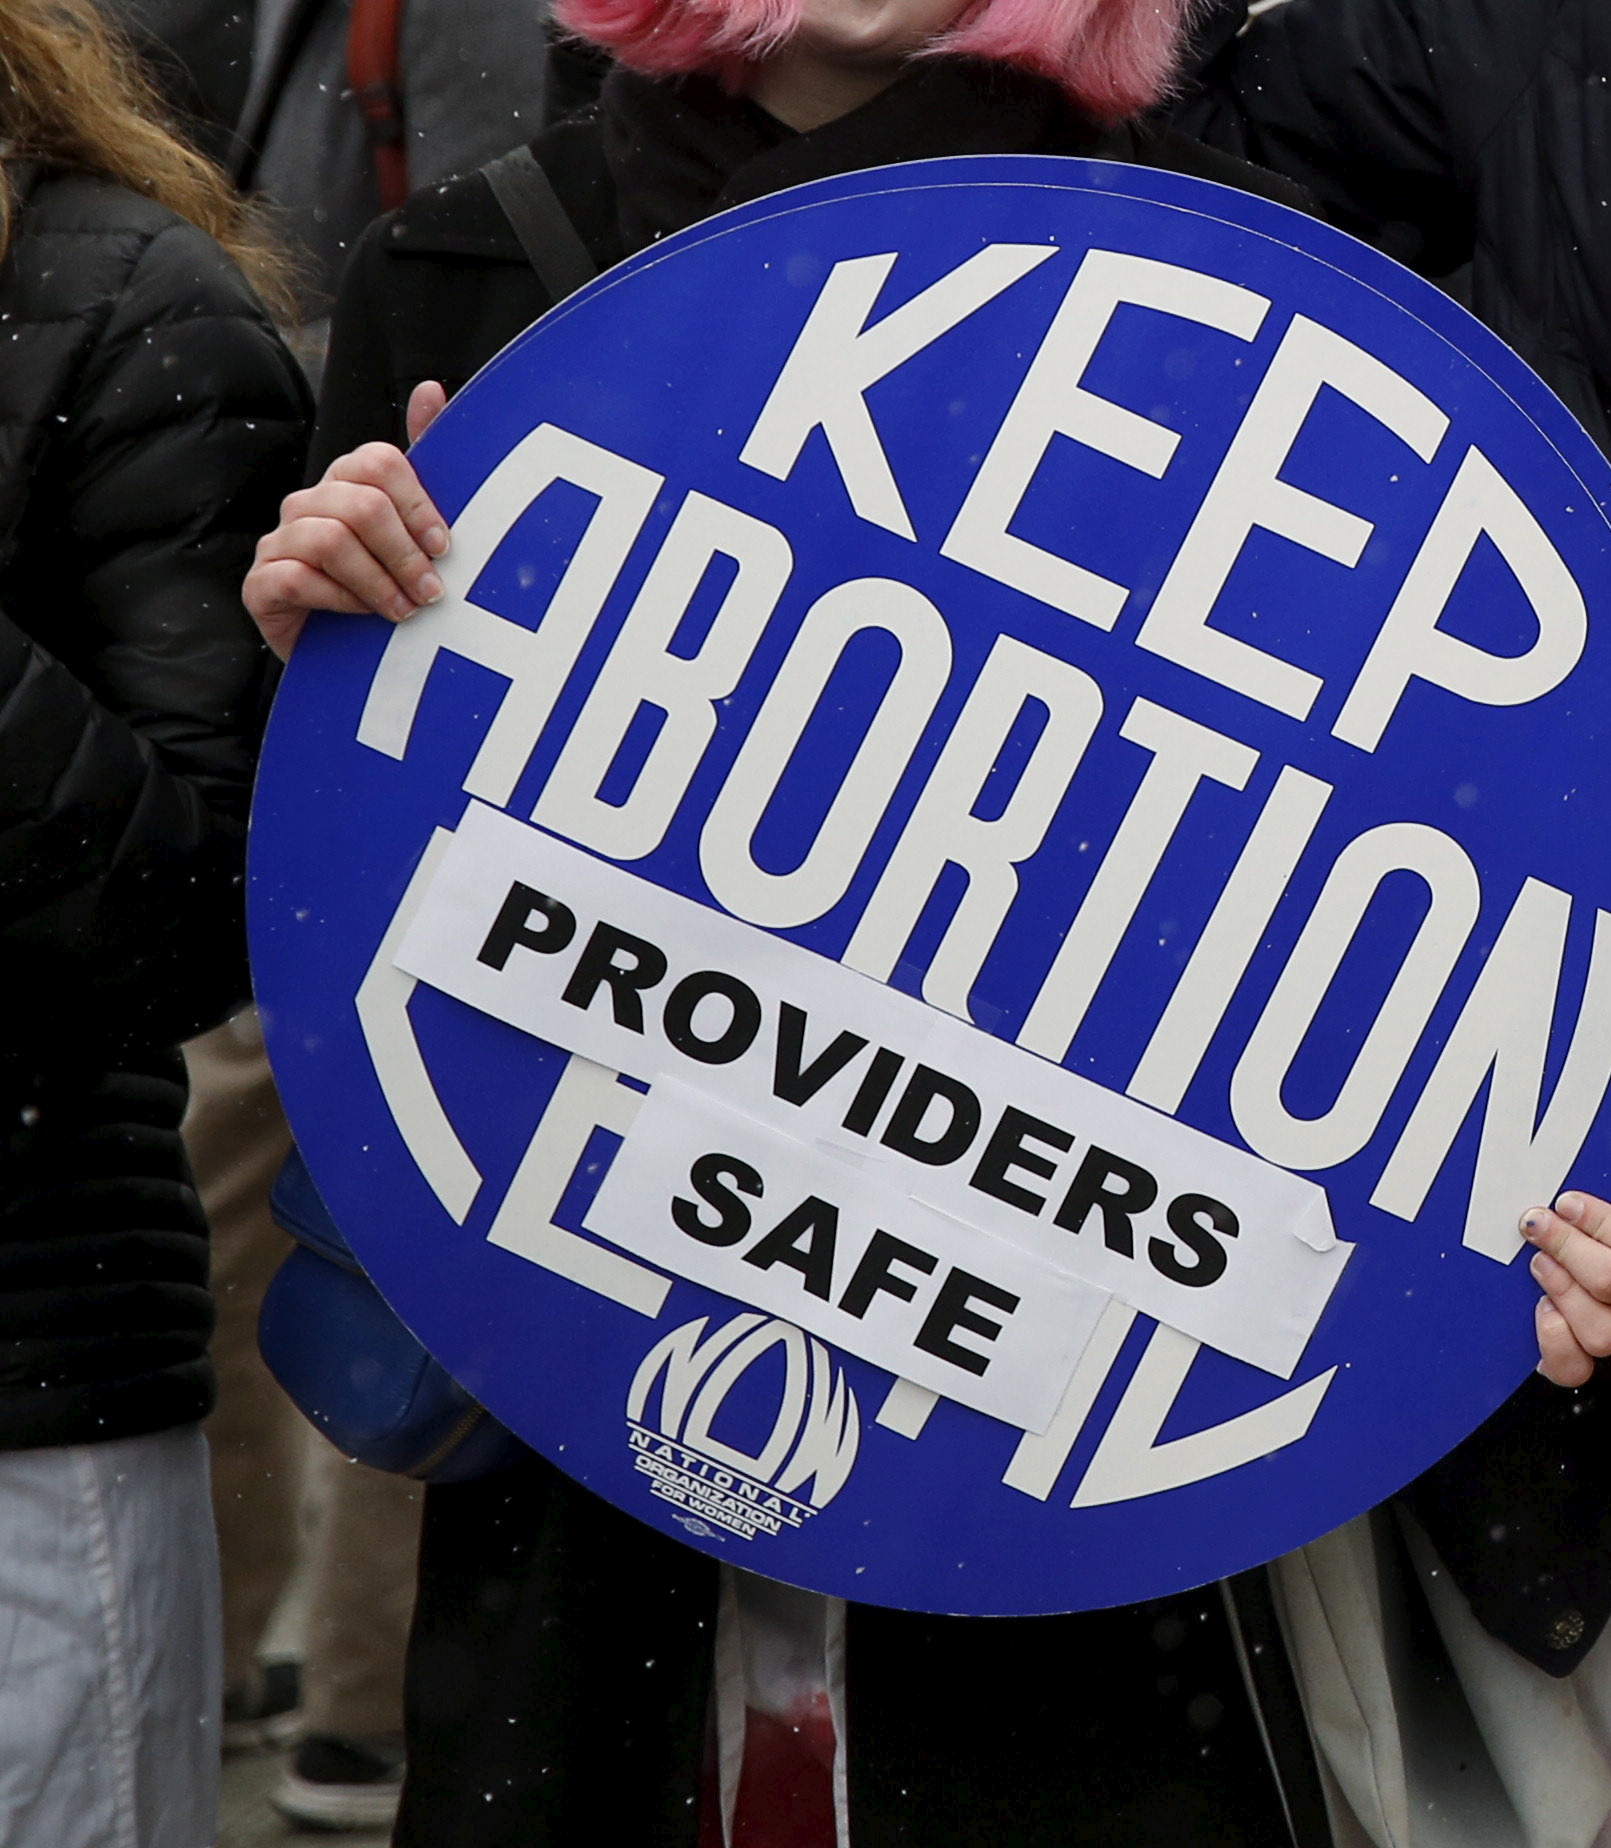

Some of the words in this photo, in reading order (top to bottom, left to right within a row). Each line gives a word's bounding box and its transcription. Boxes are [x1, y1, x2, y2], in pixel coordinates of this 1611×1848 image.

[739, 241, 1588, 755] KEEP
[475, 879, 1240, 1289] PROVIDERS
[670, 1152, 1022, 1377] SAFE
[626, 1311, 861, 1510] NOW
[629, 1430, 803, 1524] NATIONAL
[635, 1454, 782, 1533] ORGANIZATION
[651, 1479, 687, 1504] FOR
[688, 1497, 757, 1538] WOMEN
